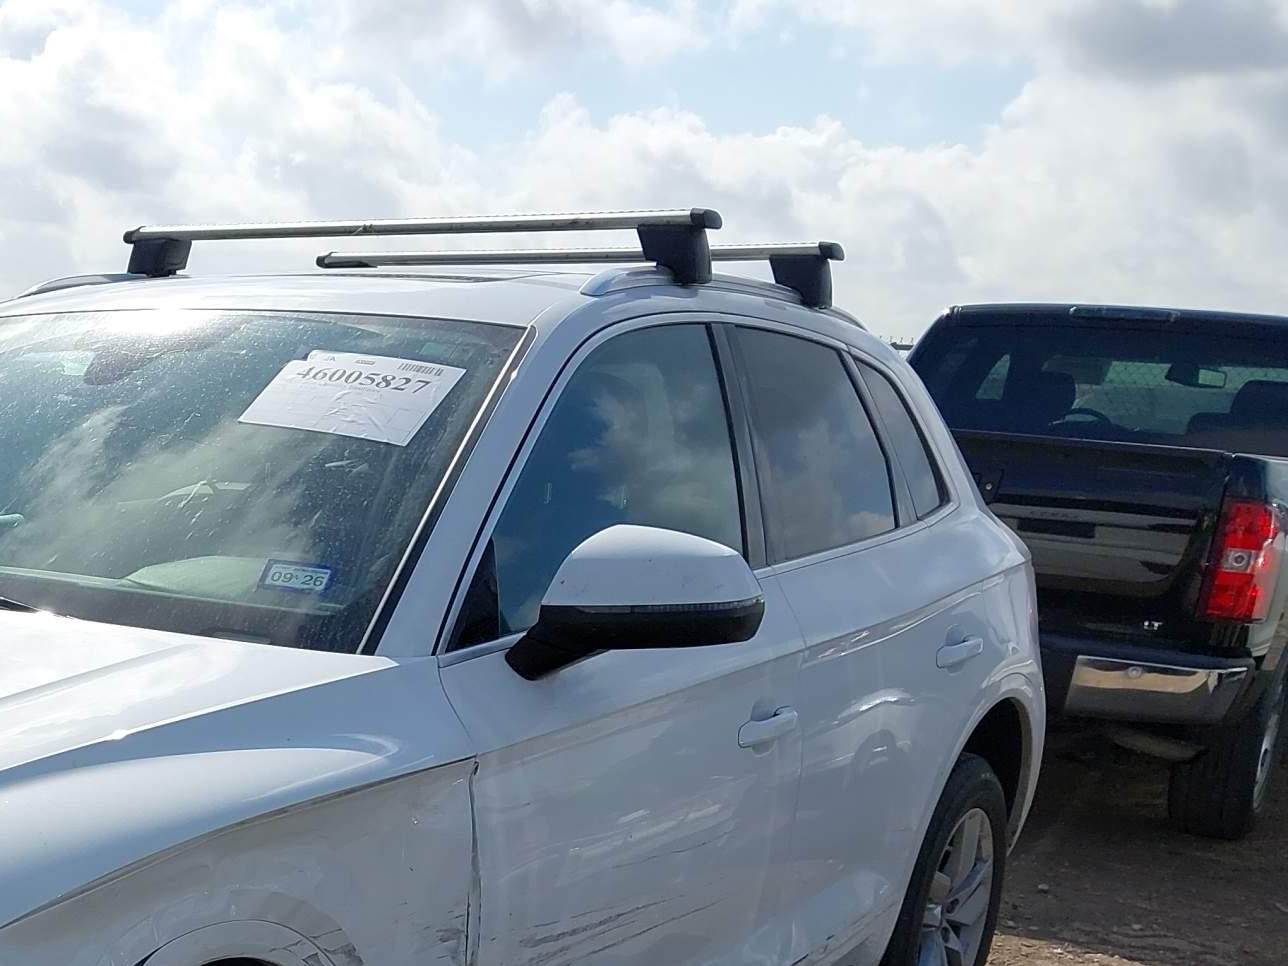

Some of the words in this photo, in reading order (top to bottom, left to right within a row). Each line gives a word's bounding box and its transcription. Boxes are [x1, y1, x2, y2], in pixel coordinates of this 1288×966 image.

[296, 365, 432, 394] 46005827
[271, 571, 294, 583] 09
[301, 574, 325, 587] 26
